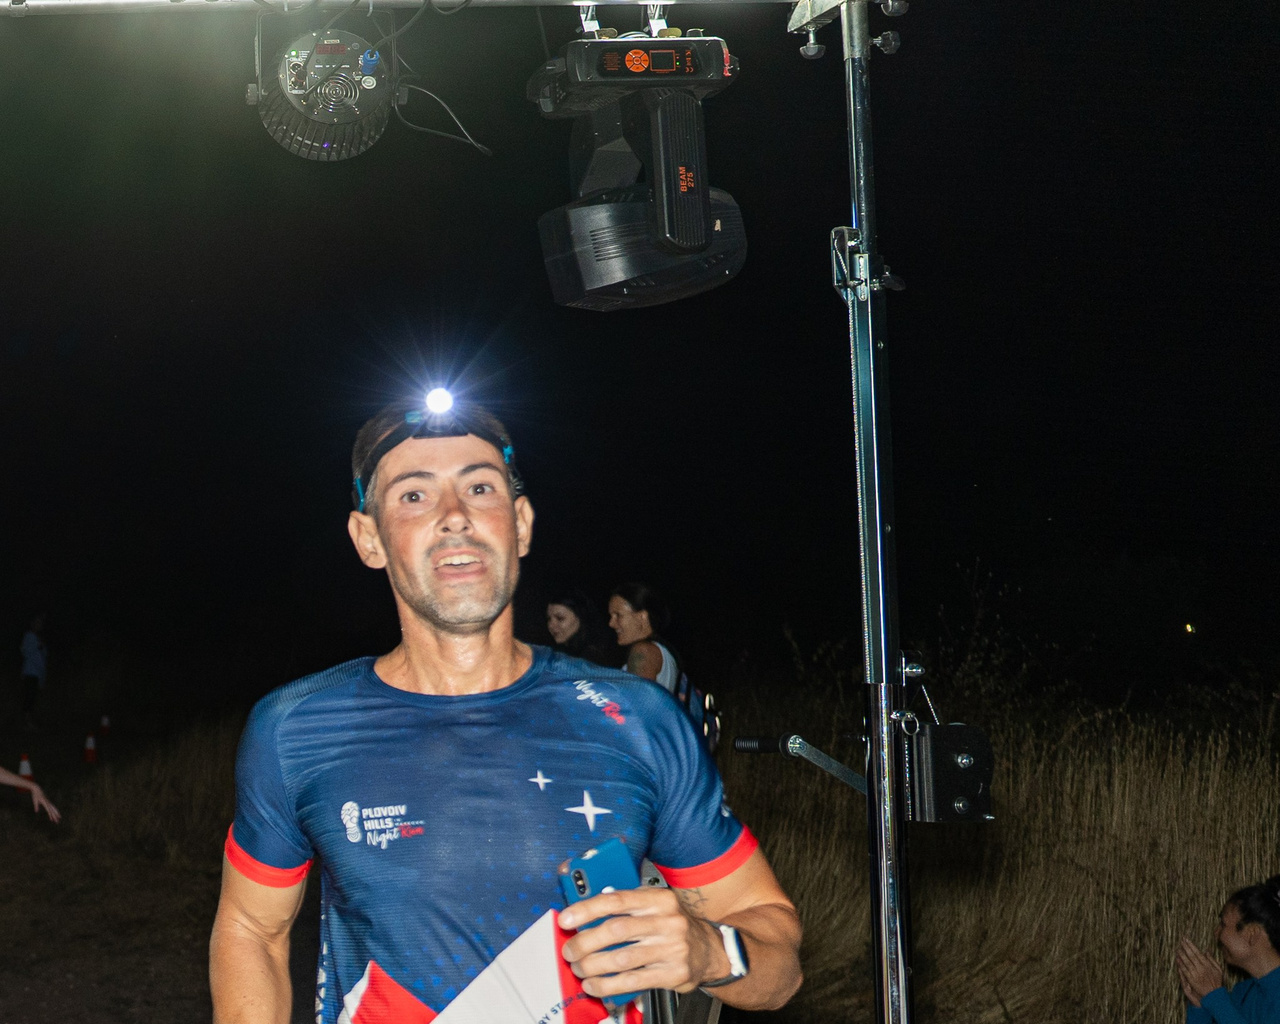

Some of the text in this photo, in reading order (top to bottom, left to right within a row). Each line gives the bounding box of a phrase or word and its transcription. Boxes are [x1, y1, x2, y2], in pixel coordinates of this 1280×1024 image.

[679, 166, 687, 192] BEAM
[361, 804, 407, 819] PLOVDIV
[363, 817, 394, 831] HILLS
[366, 827, 400, 850] Night
